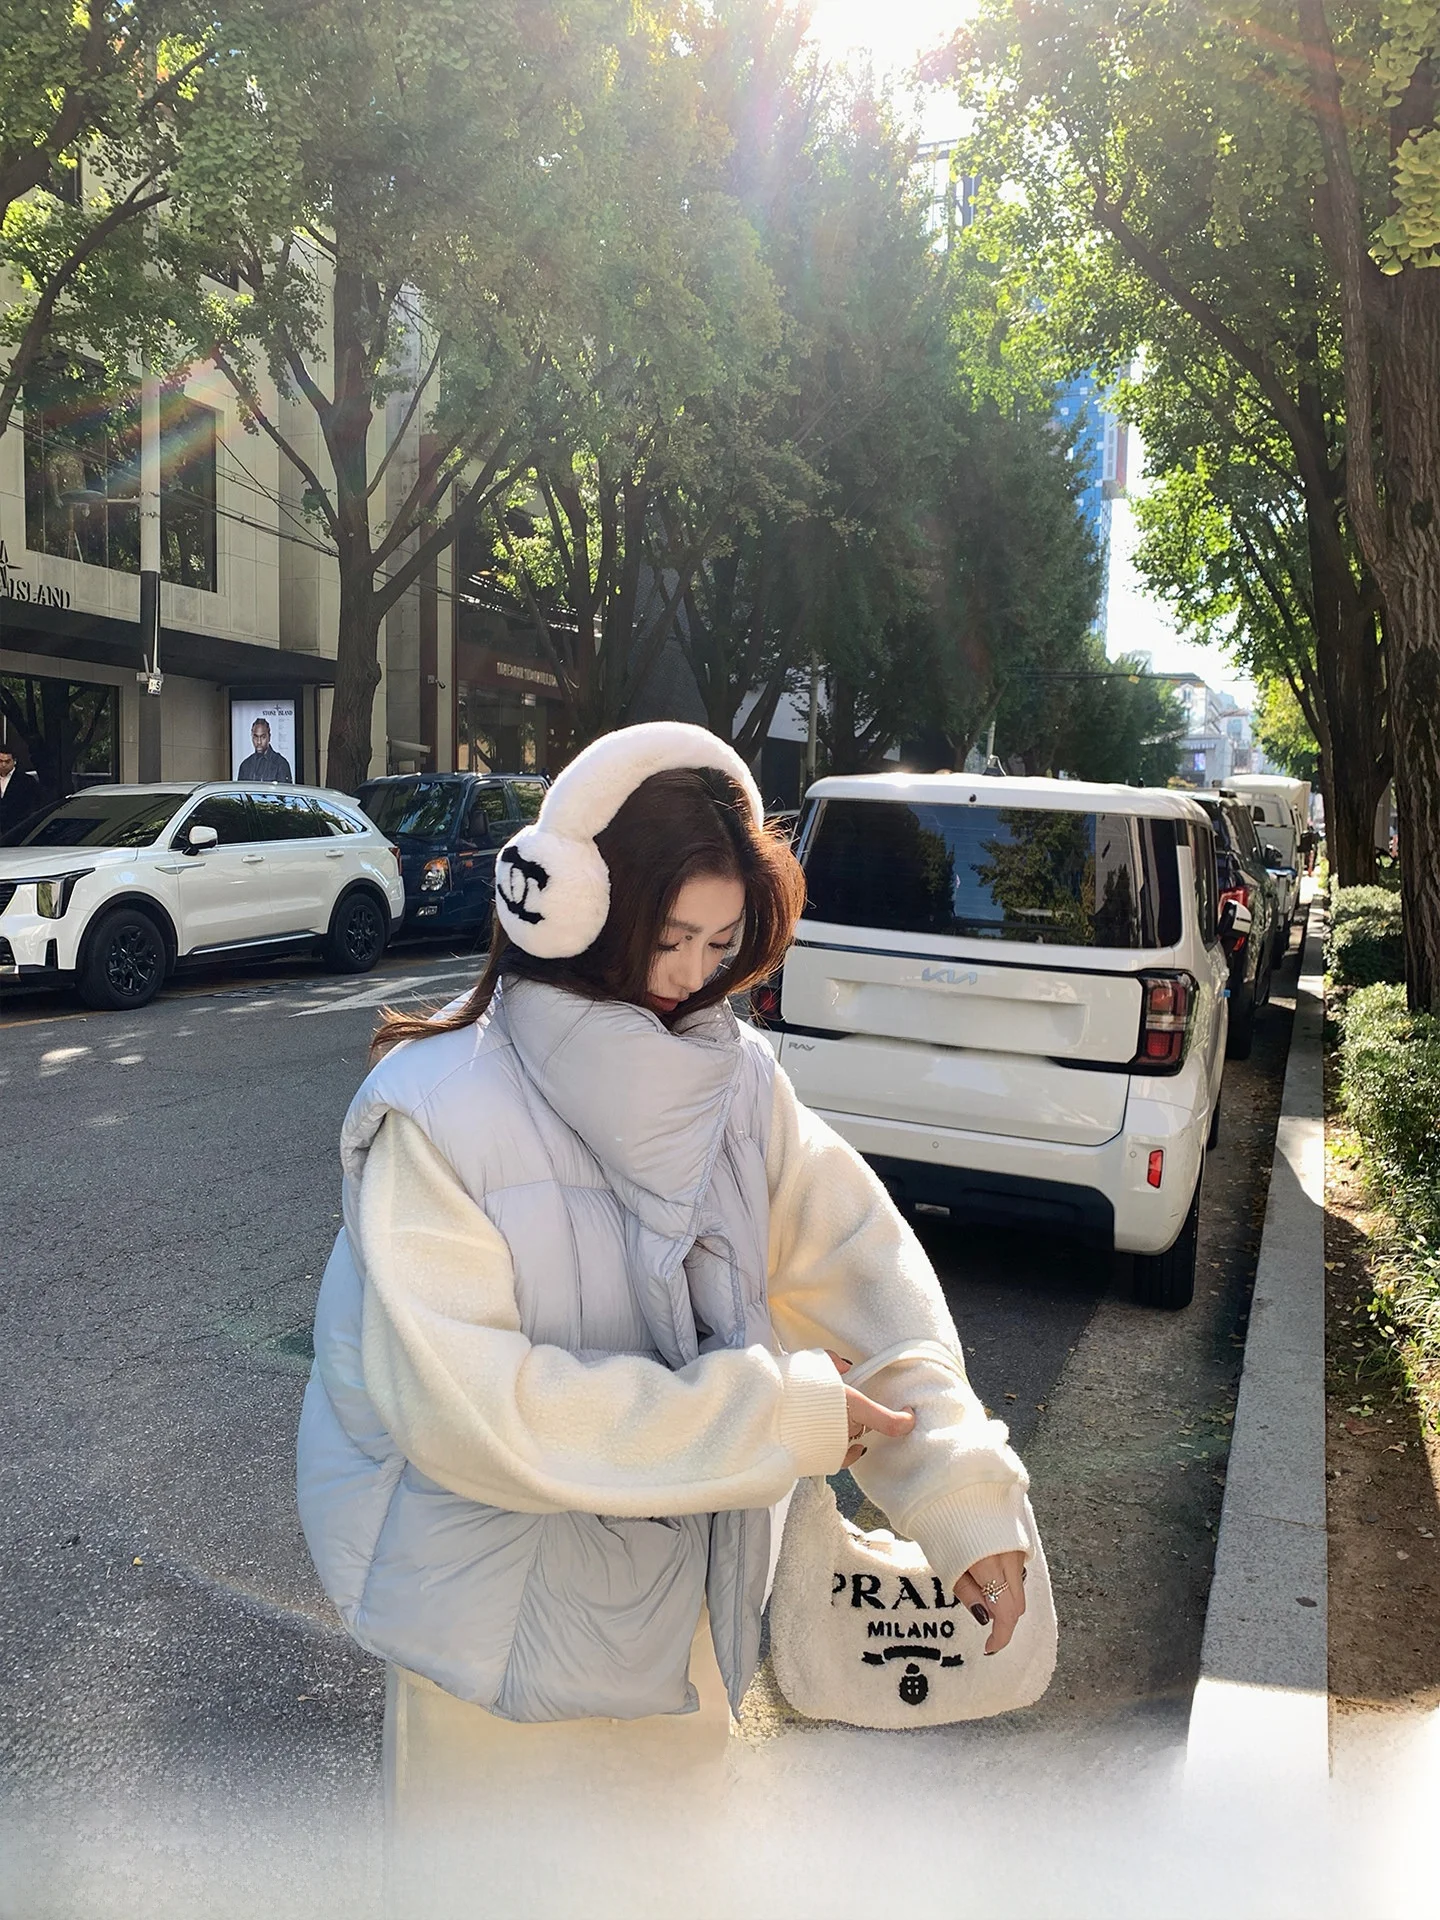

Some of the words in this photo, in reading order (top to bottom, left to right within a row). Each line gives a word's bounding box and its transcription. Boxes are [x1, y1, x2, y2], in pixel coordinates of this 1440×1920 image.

[9, 578, 71, 608] ISLAND
[788, 1042, 815, 1051] RAY
[867, 1620, 955, 1639] MILANO
